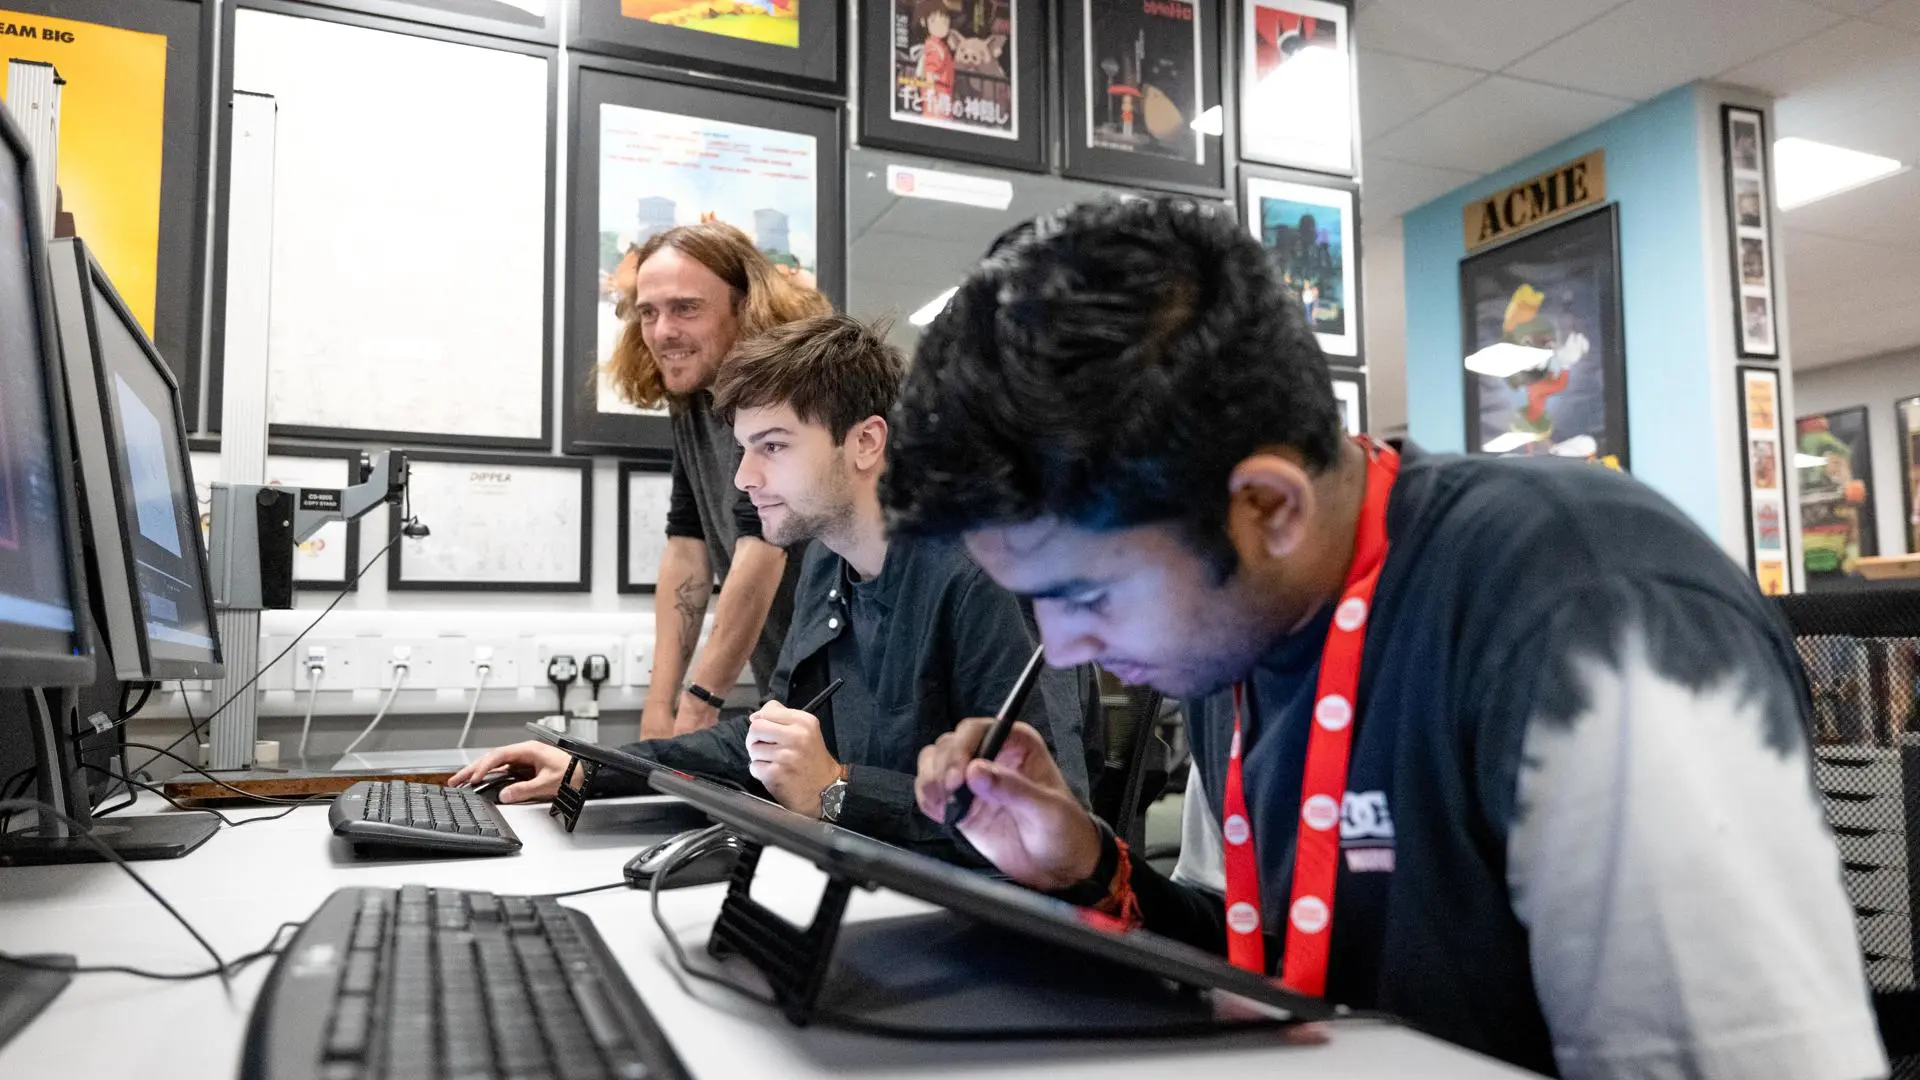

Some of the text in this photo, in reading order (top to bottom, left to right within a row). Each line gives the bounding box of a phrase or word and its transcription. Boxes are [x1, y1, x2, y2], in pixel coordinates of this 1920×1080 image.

[42, 28, 75, 44] BIG
[1478, 161, 1588, 241] ACME
[470, 471, 512, 483] DIPPER
